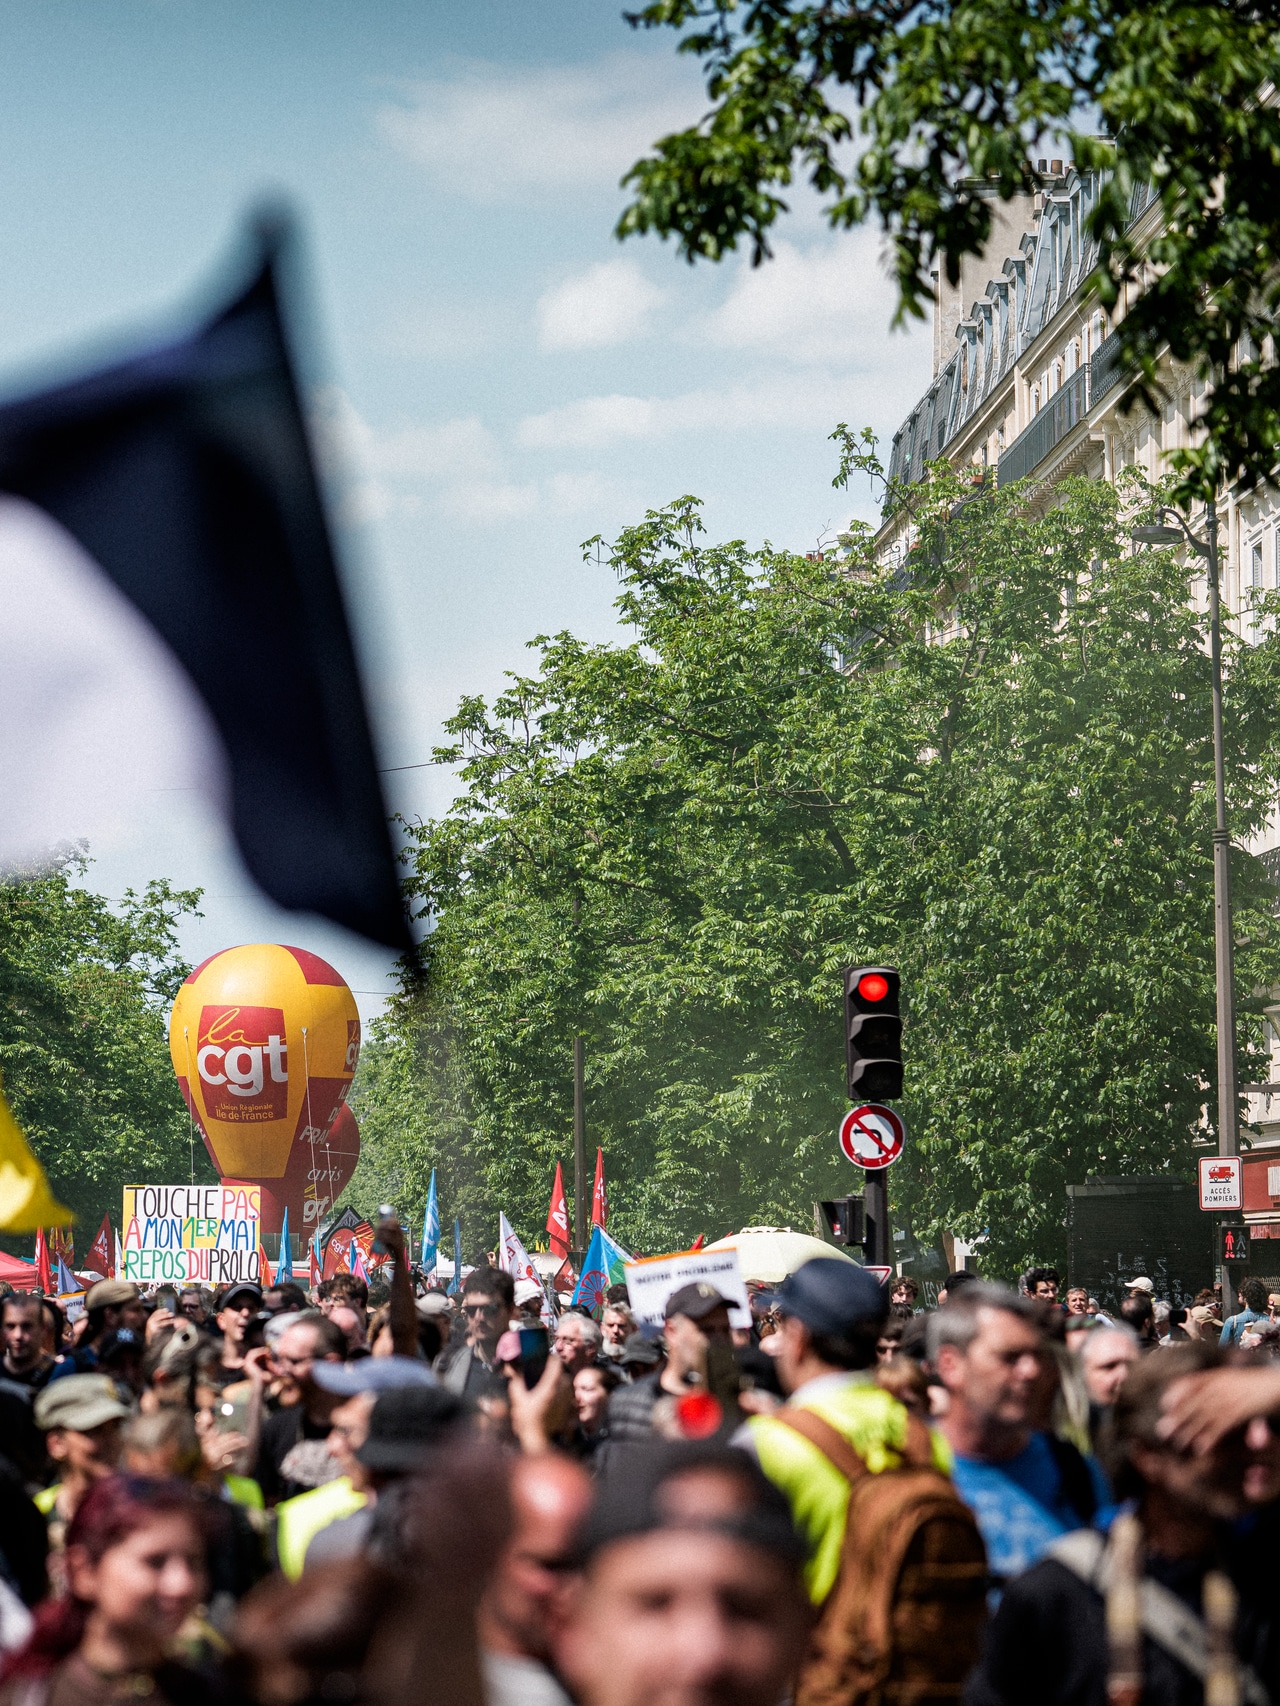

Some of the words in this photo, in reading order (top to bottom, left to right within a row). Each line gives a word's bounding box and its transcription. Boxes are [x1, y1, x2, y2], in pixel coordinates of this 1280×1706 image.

[198, 1007, 268, 1044] la
[197, 1035, 288, 1097] cgt
[299, 1125, 329, 1145] FRA
[307, 1166, 343, 1182] aris
[125, 1187, 219, 1219] TOUCHE
[222, 1189, 260, 1221] PAS
[302, 1195, 330, 1222] gt
[124, 1214, 142, 1250] À
[142, 1217, 183, 1249] MON
[183, 1216, 218, 1248] 1ER
[331, 1238, 345, 1255] cgt
[125, 1249, 186, 1280] REPOS
[186, 1249, 209, 1280] DU
[209, 1249, 260, 1281] PROLO
